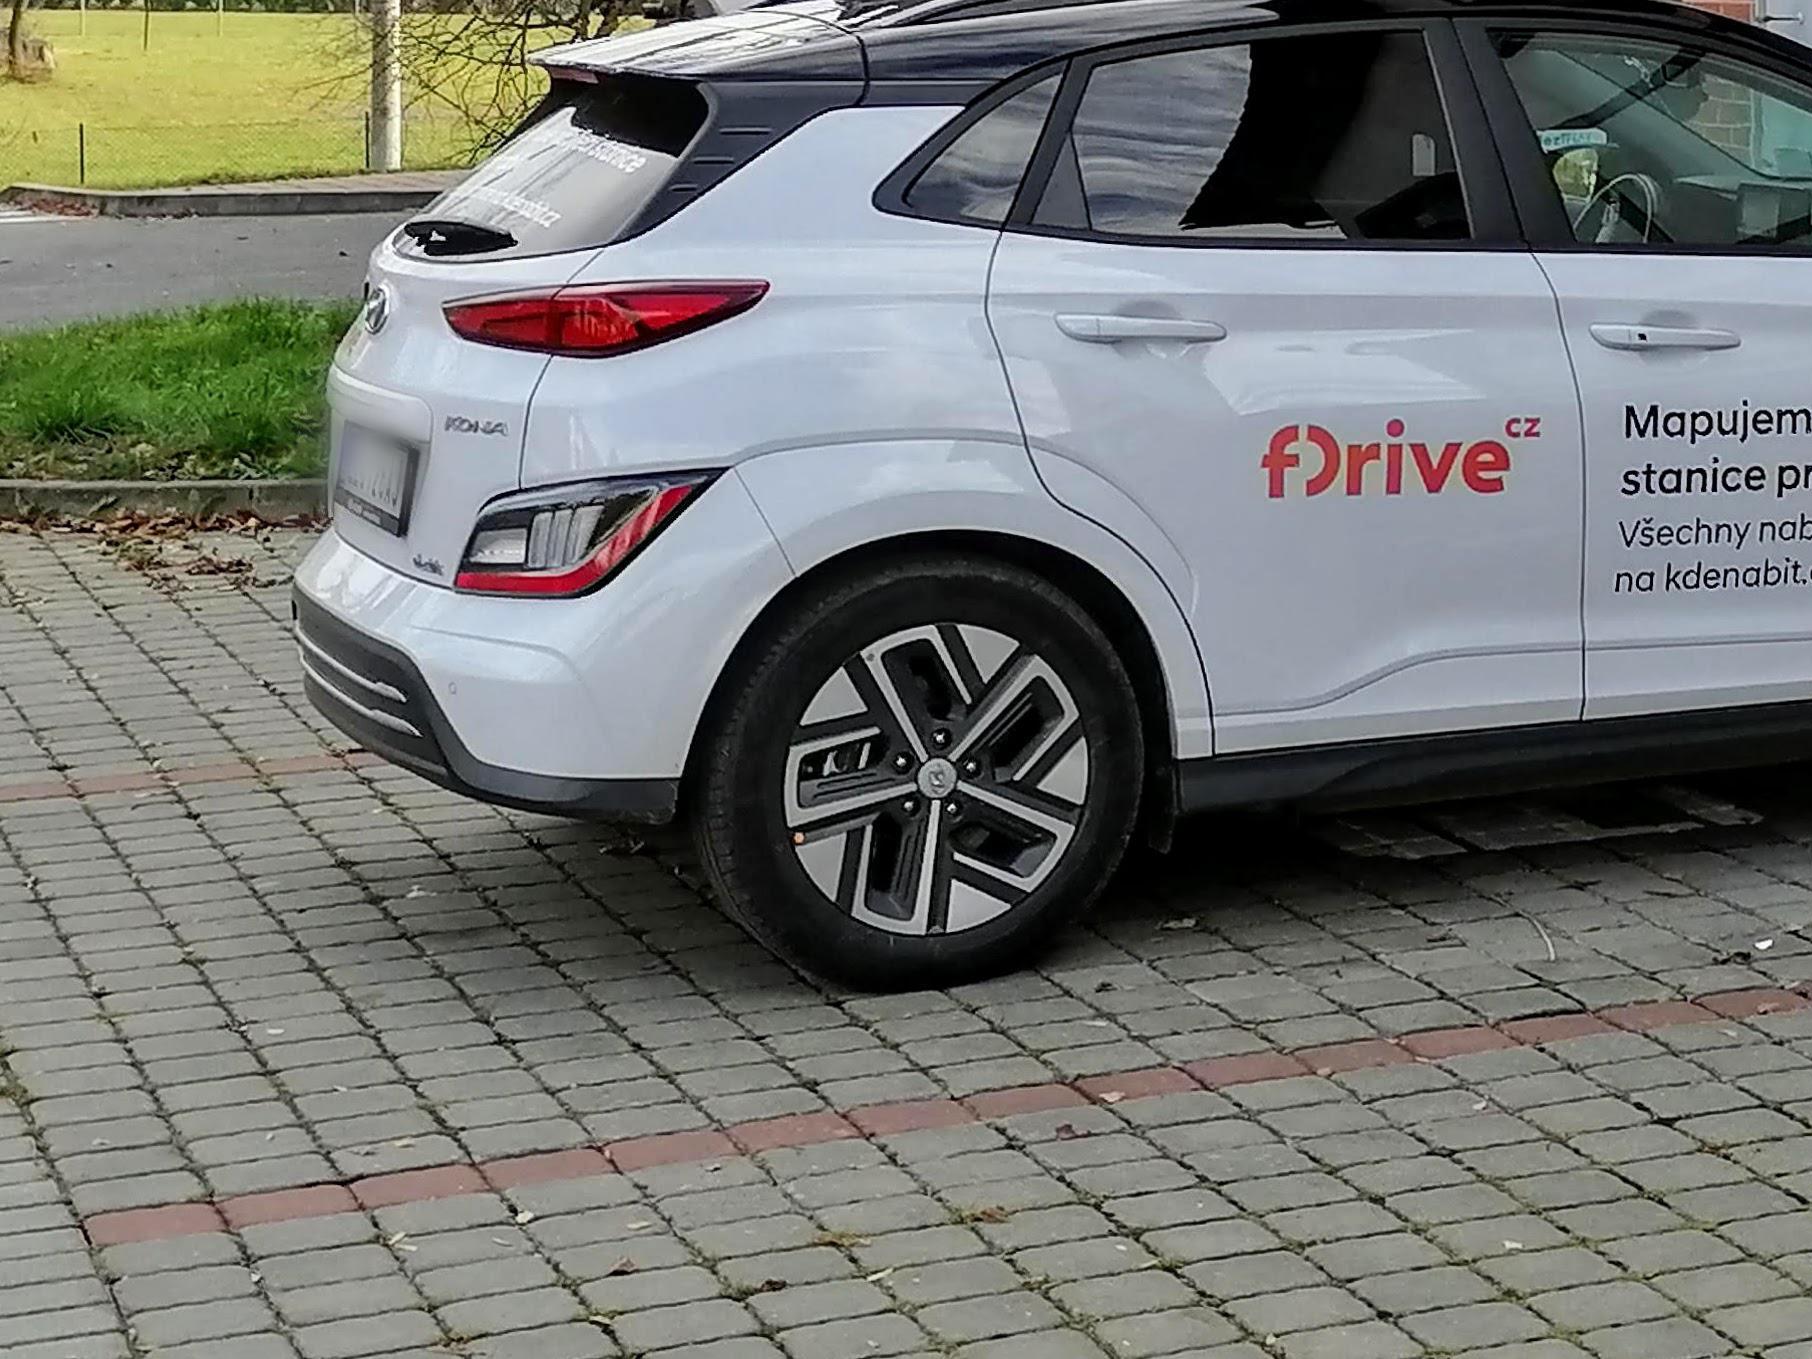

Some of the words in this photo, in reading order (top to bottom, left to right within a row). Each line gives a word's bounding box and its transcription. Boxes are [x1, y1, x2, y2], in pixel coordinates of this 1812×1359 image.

[1620, 456, 1767, 496] stanice
[1618, 516, 1752, 550] Všechny
[1614, 571, 1656, 593] na
